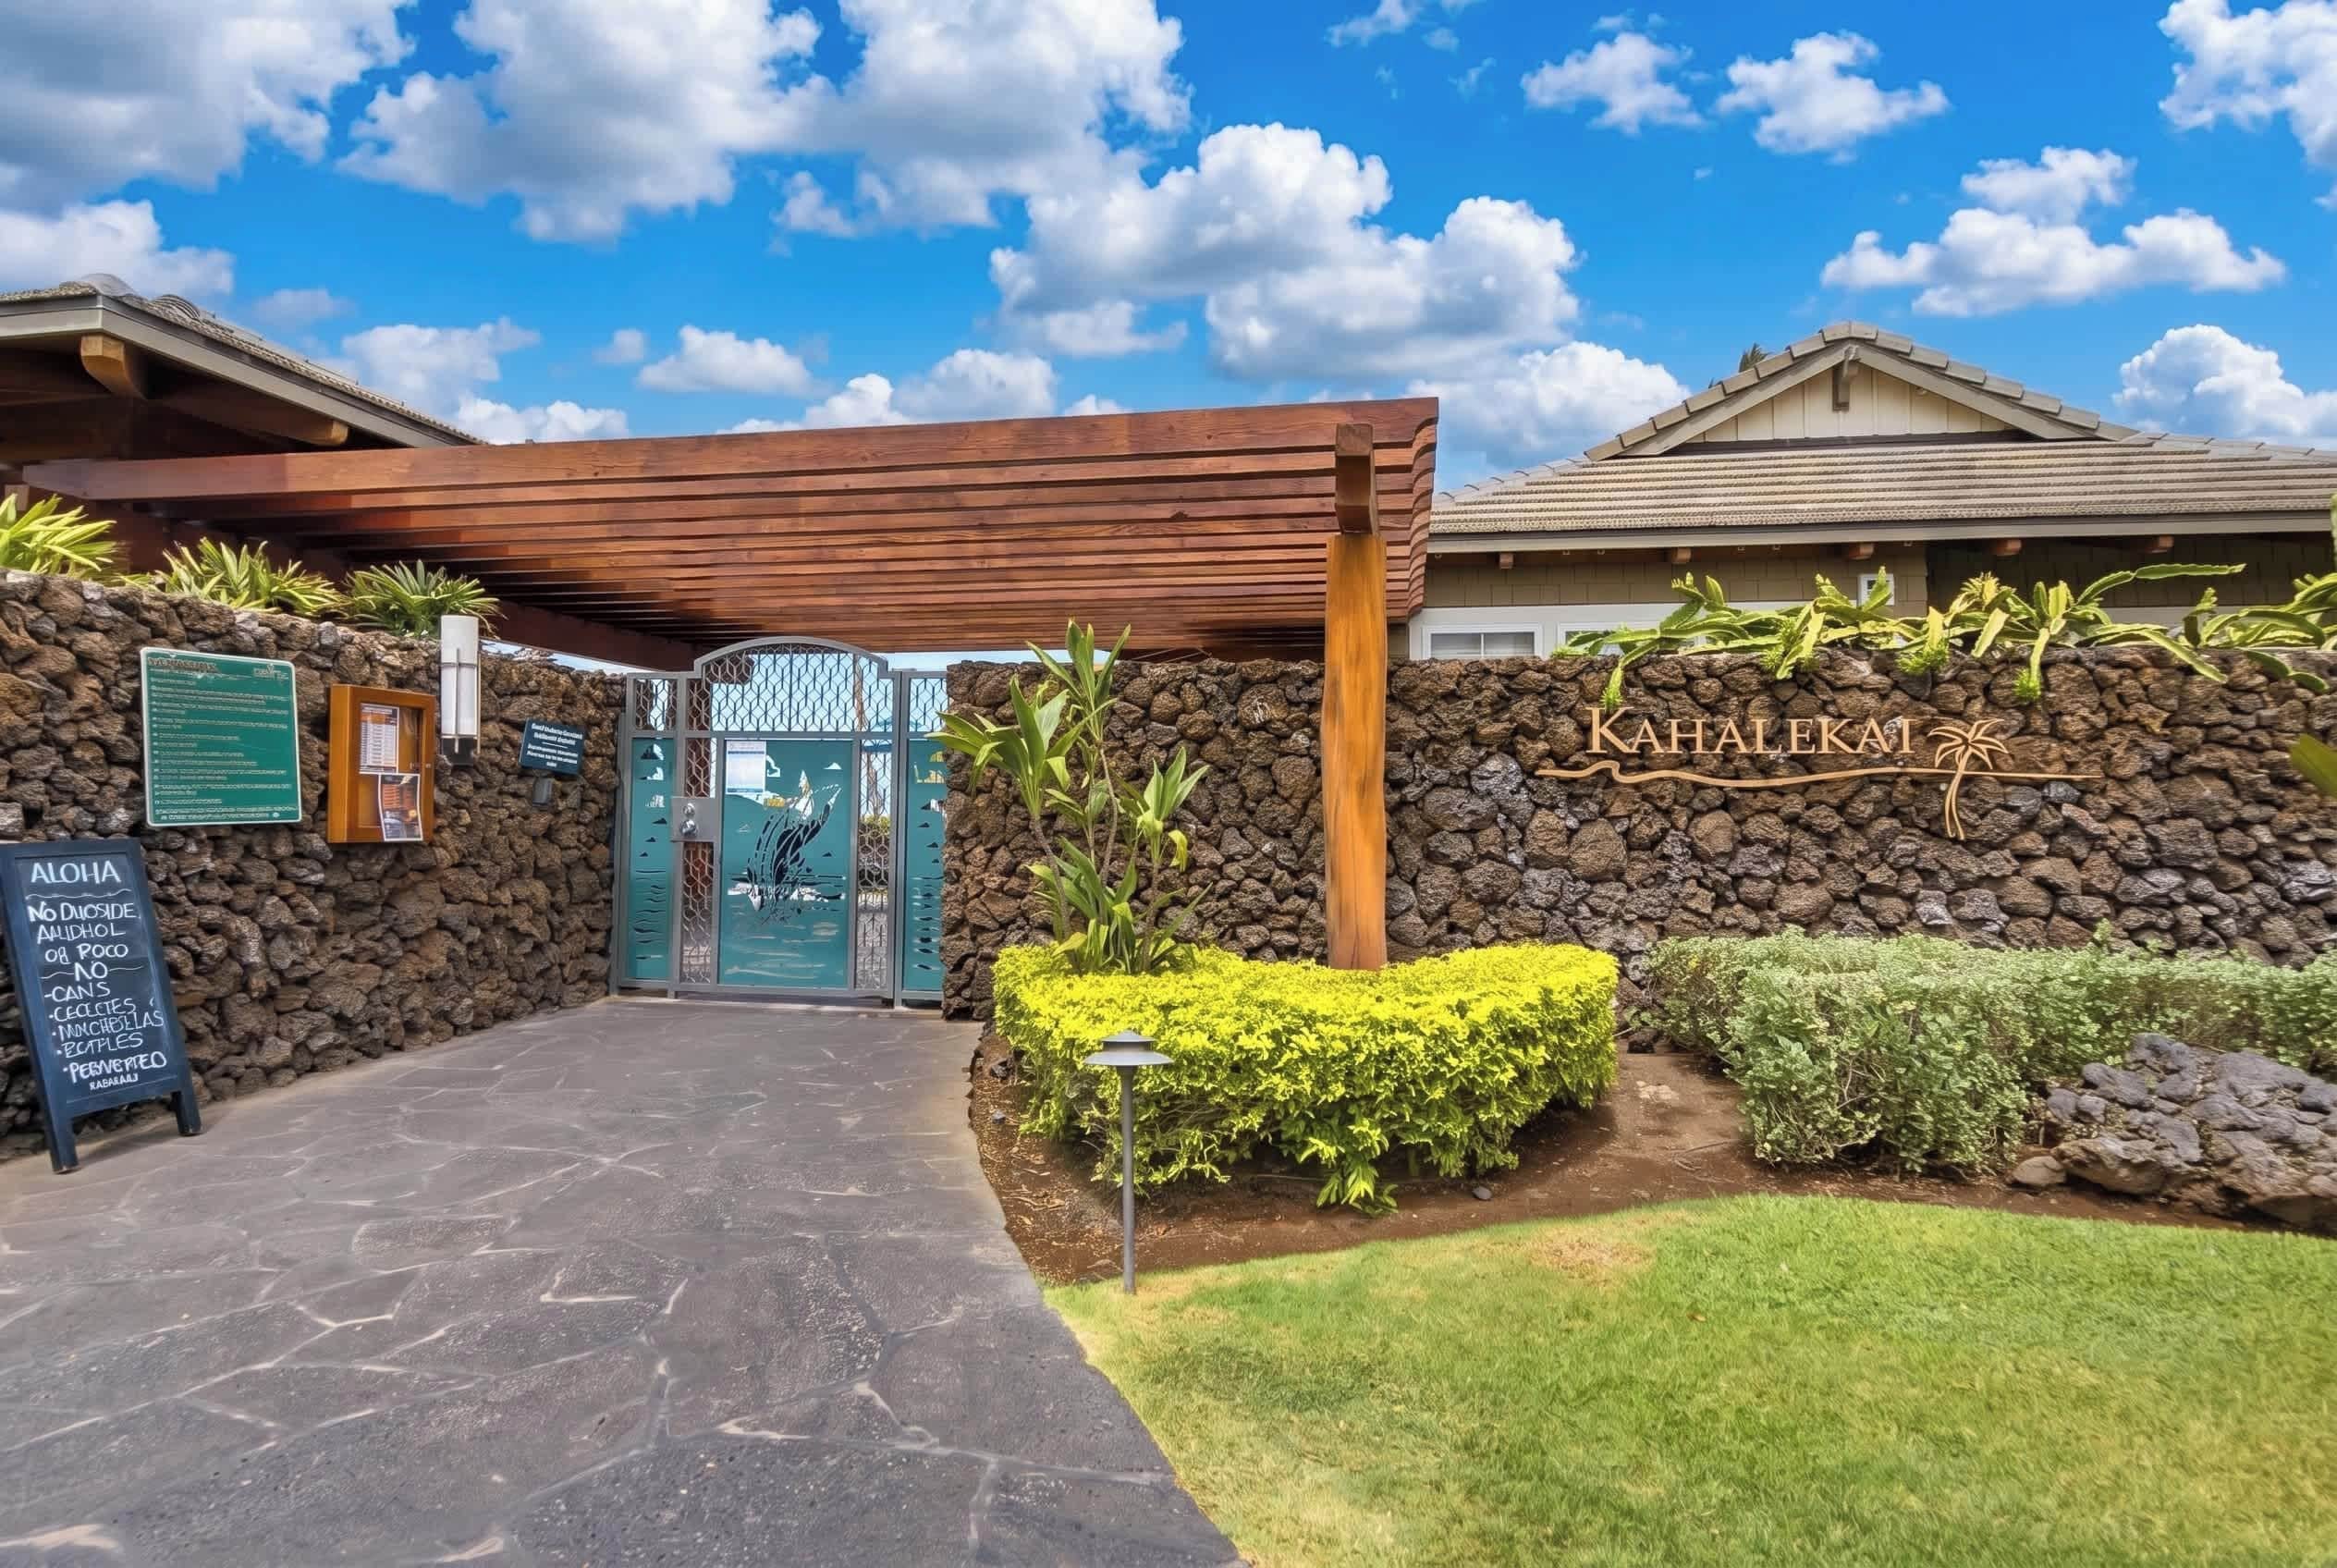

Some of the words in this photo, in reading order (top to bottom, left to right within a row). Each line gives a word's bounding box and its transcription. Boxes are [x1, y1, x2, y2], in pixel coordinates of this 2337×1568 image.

[1585, 706, 1916, 754] KAHALEKAI
[31, 860, 121, 885] ALOHA
[74, 961, 108, 982] NO
